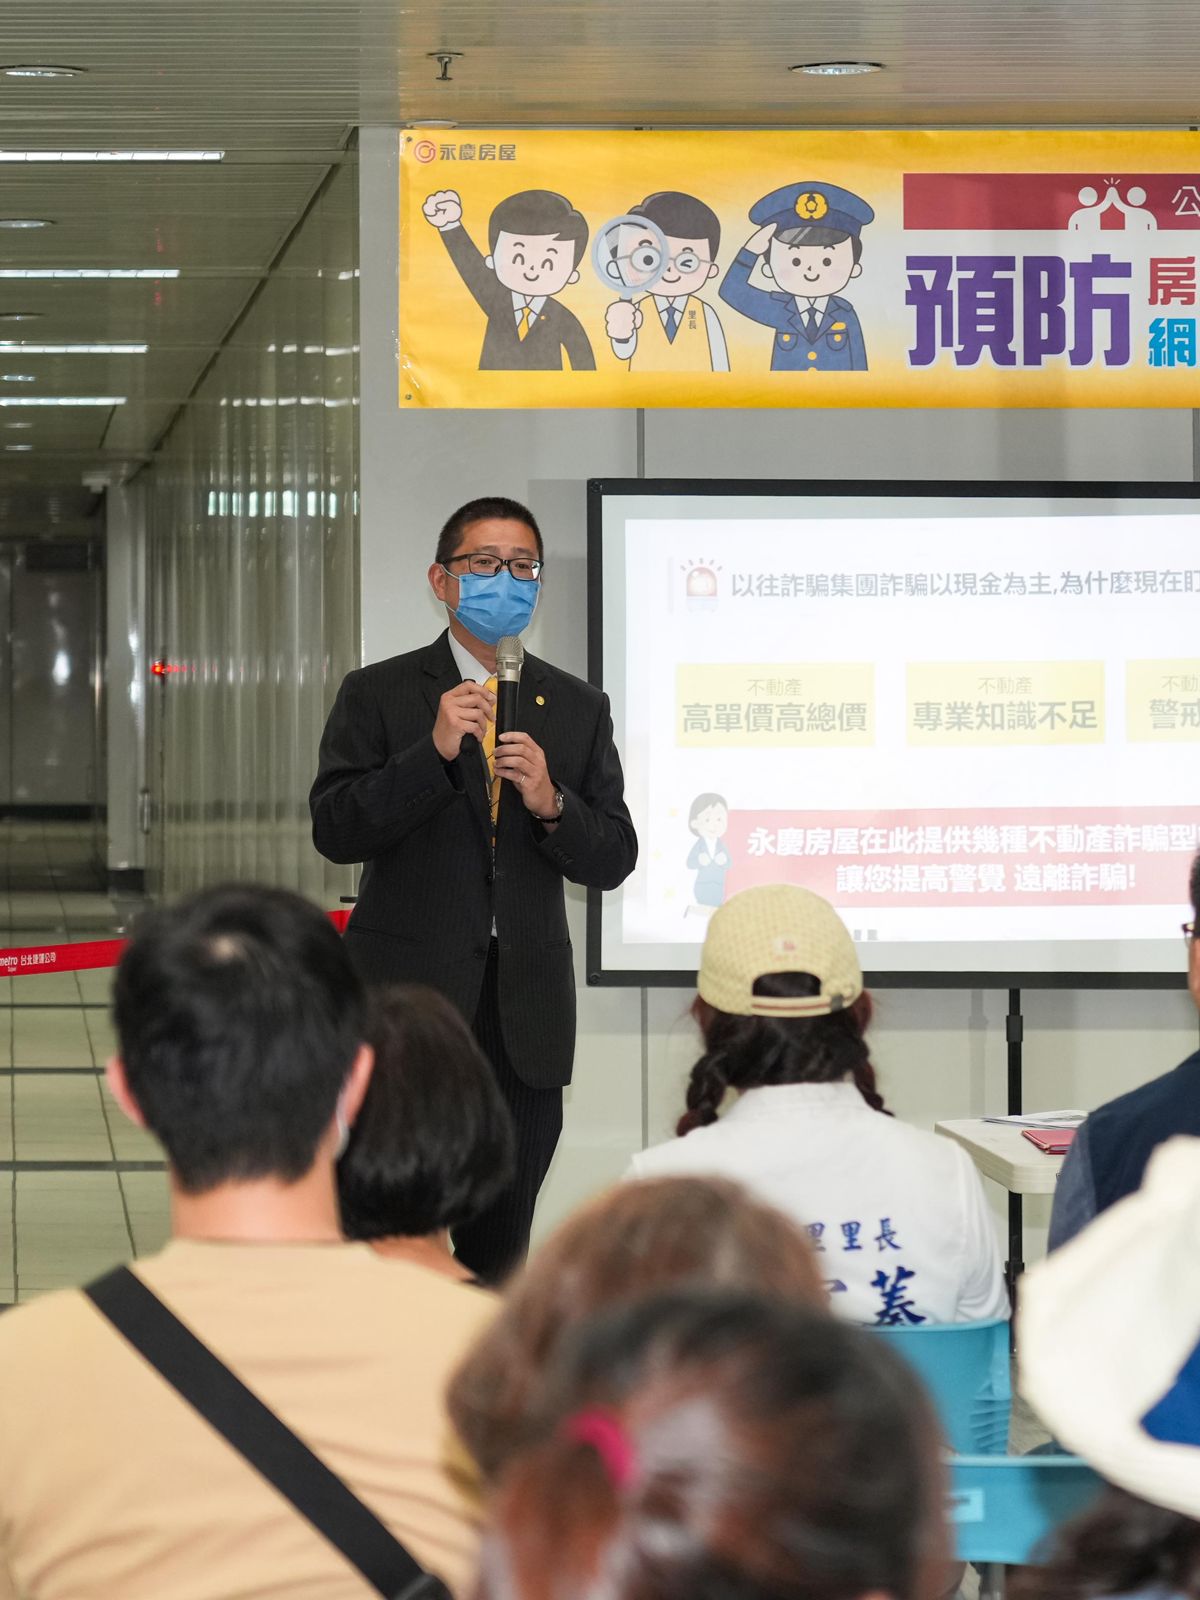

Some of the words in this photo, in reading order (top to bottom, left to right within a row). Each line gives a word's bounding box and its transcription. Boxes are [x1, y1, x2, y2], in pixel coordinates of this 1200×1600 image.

[440, 143, 516, 161] 永慶房屋
[905, 253, 1132, 367] 預防
[747, 678, 802, 697] 不動產
[977, 676, 1033, 695] 不動產
[682, 702, 868, 733] 高單價高總價
[913, 701, 1098, 732] 專業知識不足
[835, 863, 1006, 893] 讓您提高警覺
[1014, 862, 1137, 892] 遠離詐騙!
